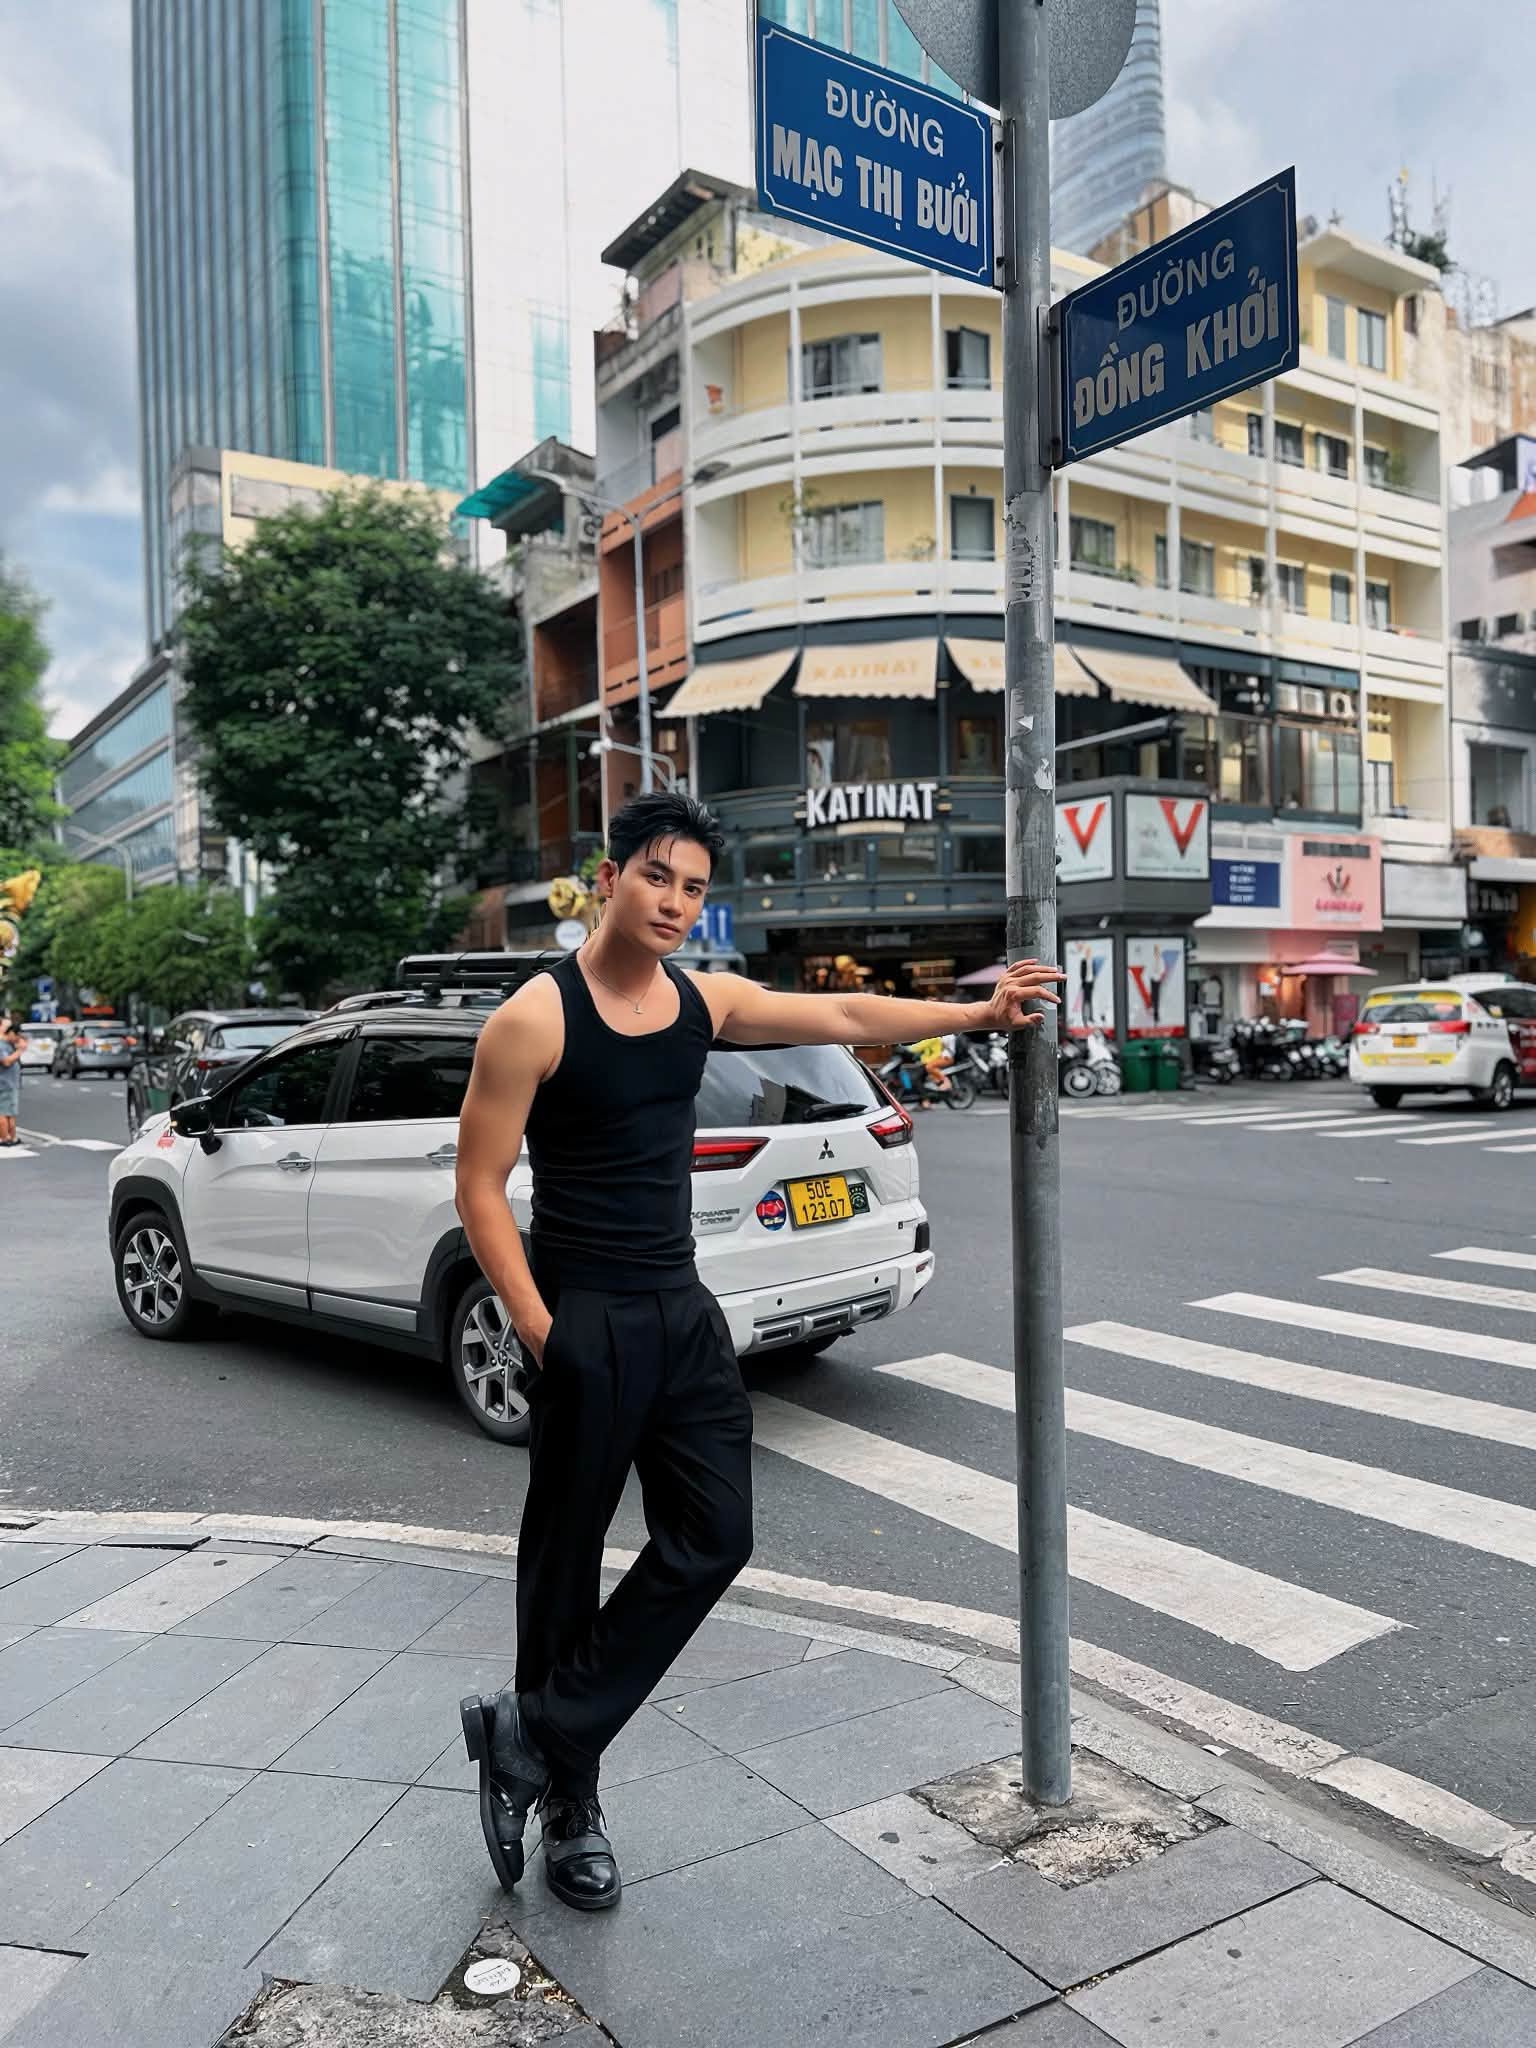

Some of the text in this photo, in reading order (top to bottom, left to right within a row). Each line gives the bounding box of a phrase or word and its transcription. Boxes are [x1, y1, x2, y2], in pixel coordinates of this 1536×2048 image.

[825, 79, 944, 158] ĐƯỜNG
[773, 122, 978, 248] MẠC THỊ BƯỞI
[1116, 239, 1236, 330] ĐƯỜNG
[1073, 266, 1279, 429] ĐỒNG KHỞI
[806, 782, 938, 827] KATINAT
[802, 1199, 845, 1222] 123.07
[806, 1180, 833, 1200] 50E
